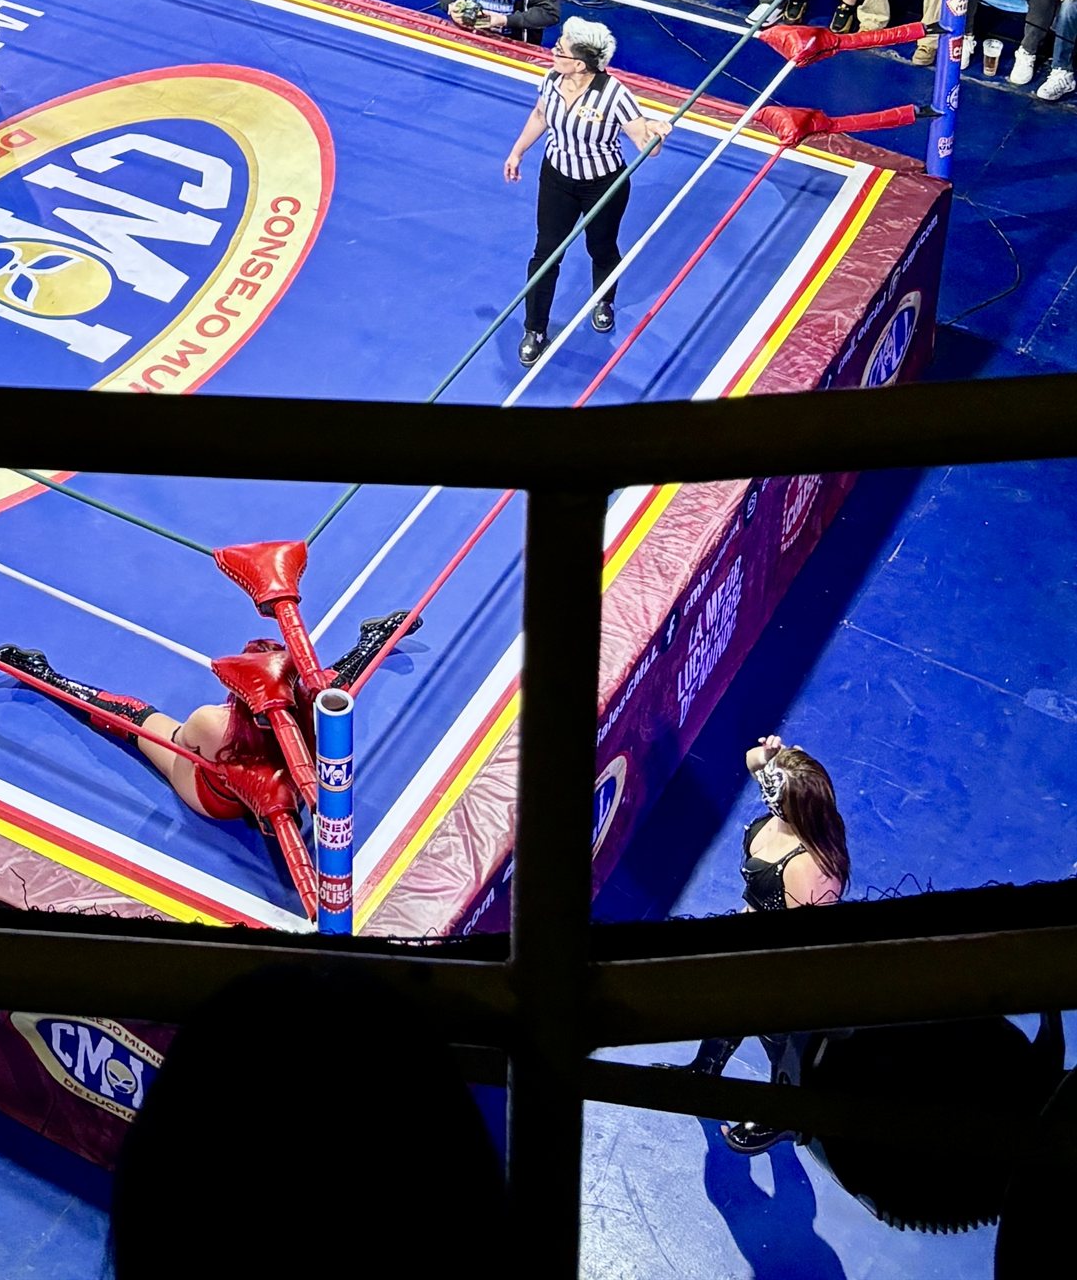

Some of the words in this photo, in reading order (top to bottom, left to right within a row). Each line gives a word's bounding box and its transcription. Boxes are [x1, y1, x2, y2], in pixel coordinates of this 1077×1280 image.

[196, 195, 302, 338] CONSEJO
[687, 613, 704, 656] LA
[705, 554, 742, 632] MEJOR
[63, 1077, 85, 1096] DE
